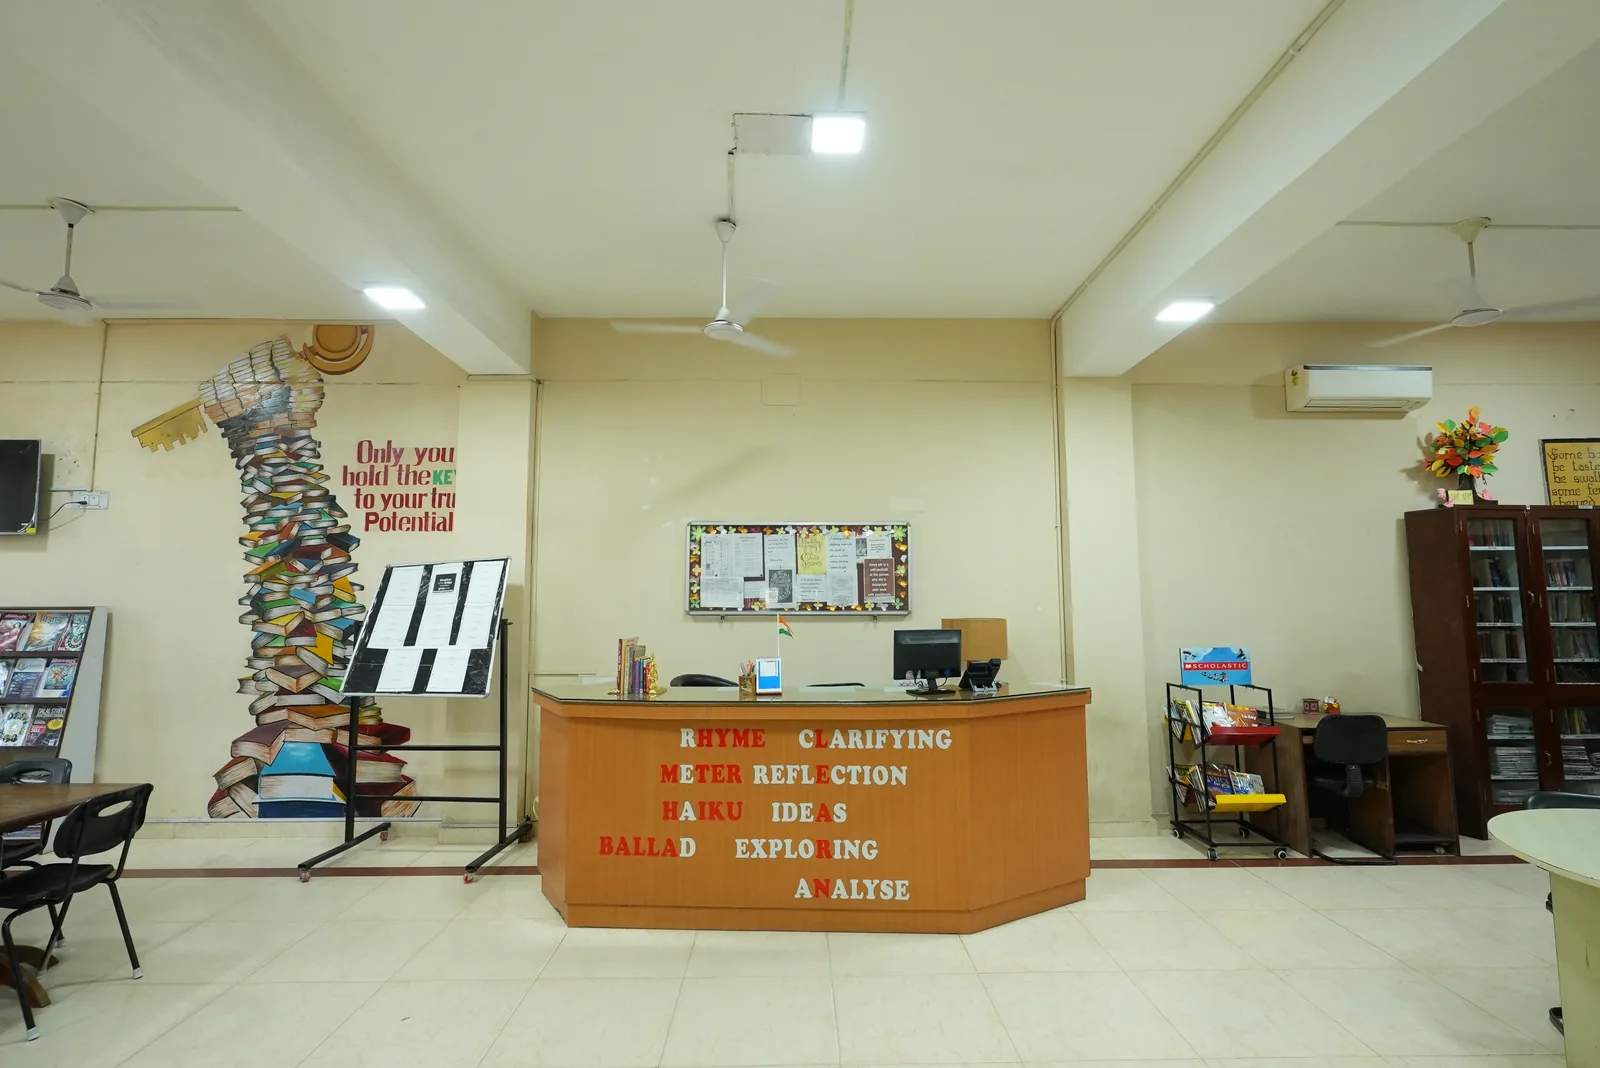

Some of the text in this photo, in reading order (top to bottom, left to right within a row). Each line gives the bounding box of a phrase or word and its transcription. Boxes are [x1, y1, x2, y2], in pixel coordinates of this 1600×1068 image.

[357, 440, 454, 467] Only you
[1547, 447, 1600, 460] Some bo
[342, 464, 456, 486] hold the KE
[1552, 460, 1600, 472] be taste
[1553, 471, 1600, 484] be swall
[354, 487, 456, 511] to your tru
[1552, 488, 1581, 496] some
[364, 511, 454, 532] Potential
[680, 728, 952, 749] RHYME CLARIFYING
[660, 764, 908, 786] METER REFLECTION
[662, 801, 847, 822] HAIKU IDEAS
[599, 836, 879, 860] BALLAD EXPLORING
[794, 878, 910, 900] ANALYSE
